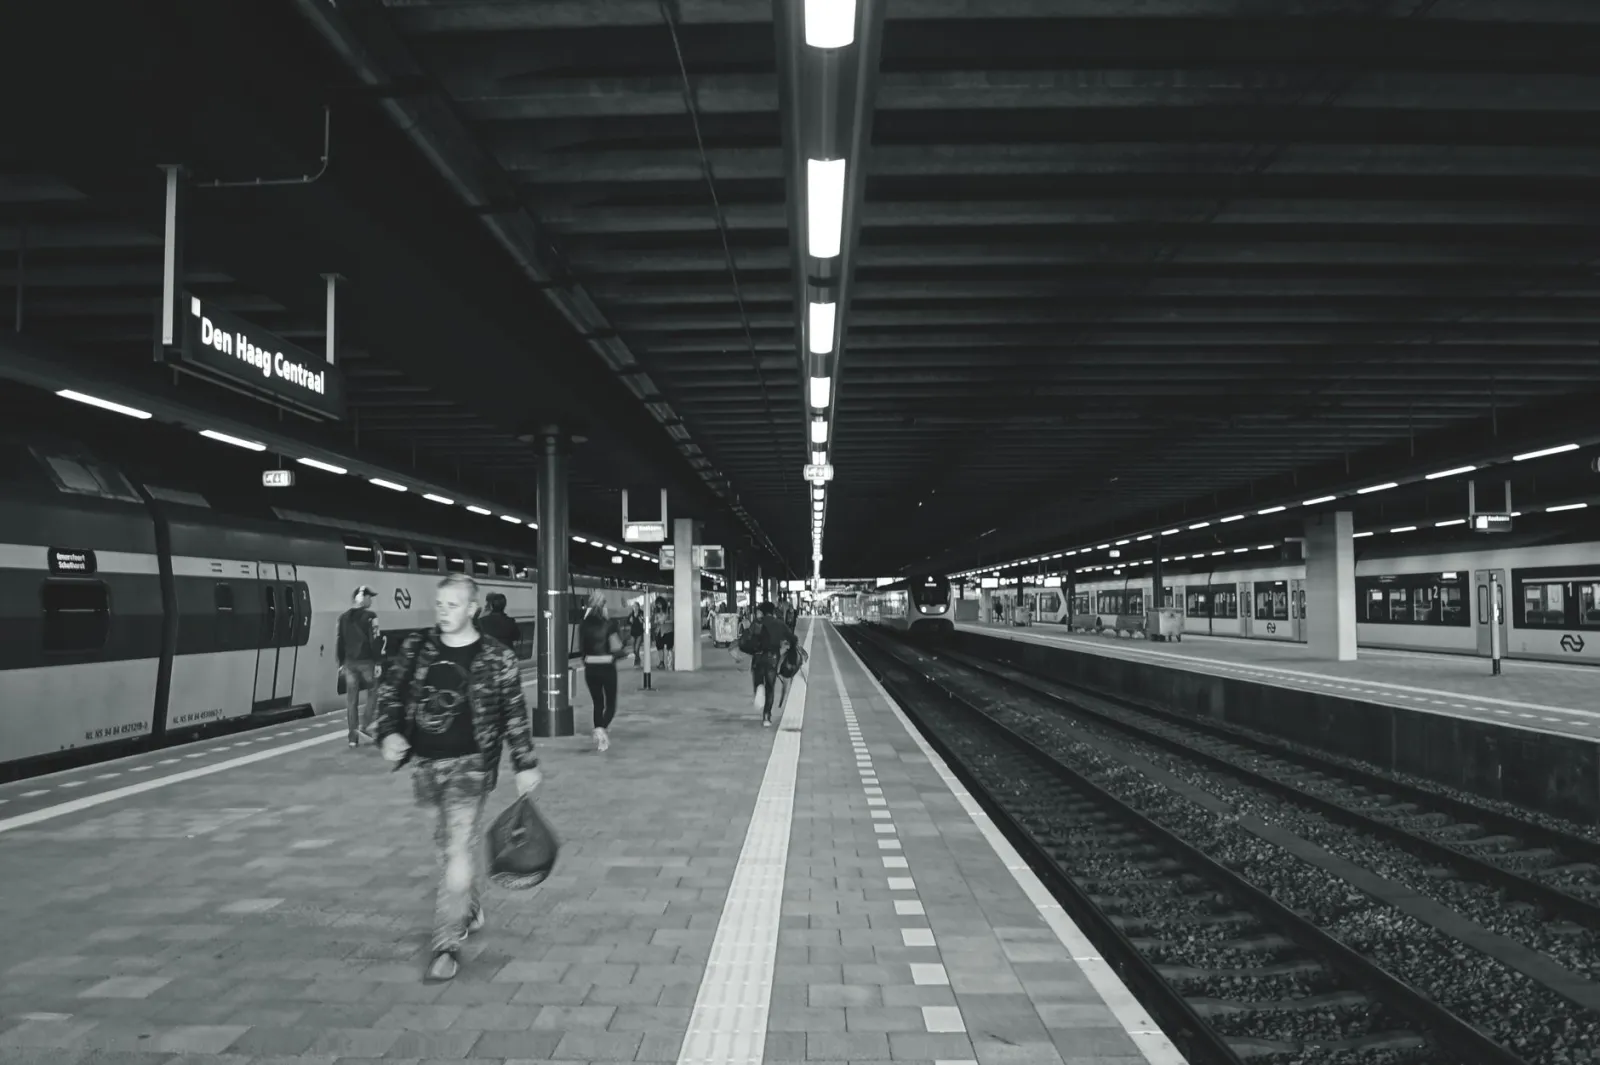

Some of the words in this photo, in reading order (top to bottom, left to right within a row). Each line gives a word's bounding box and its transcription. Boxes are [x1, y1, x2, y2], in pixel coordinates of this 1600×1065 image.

[202, 317, 232, 355] Den
[236, 332, 272, 378] Haag
[274, 352, 325, 394] Centraal
[1433, 585, 1439, 599] 2
[1567, 582, 1573, 597] 1
[380, 635, 387, 655] 2
